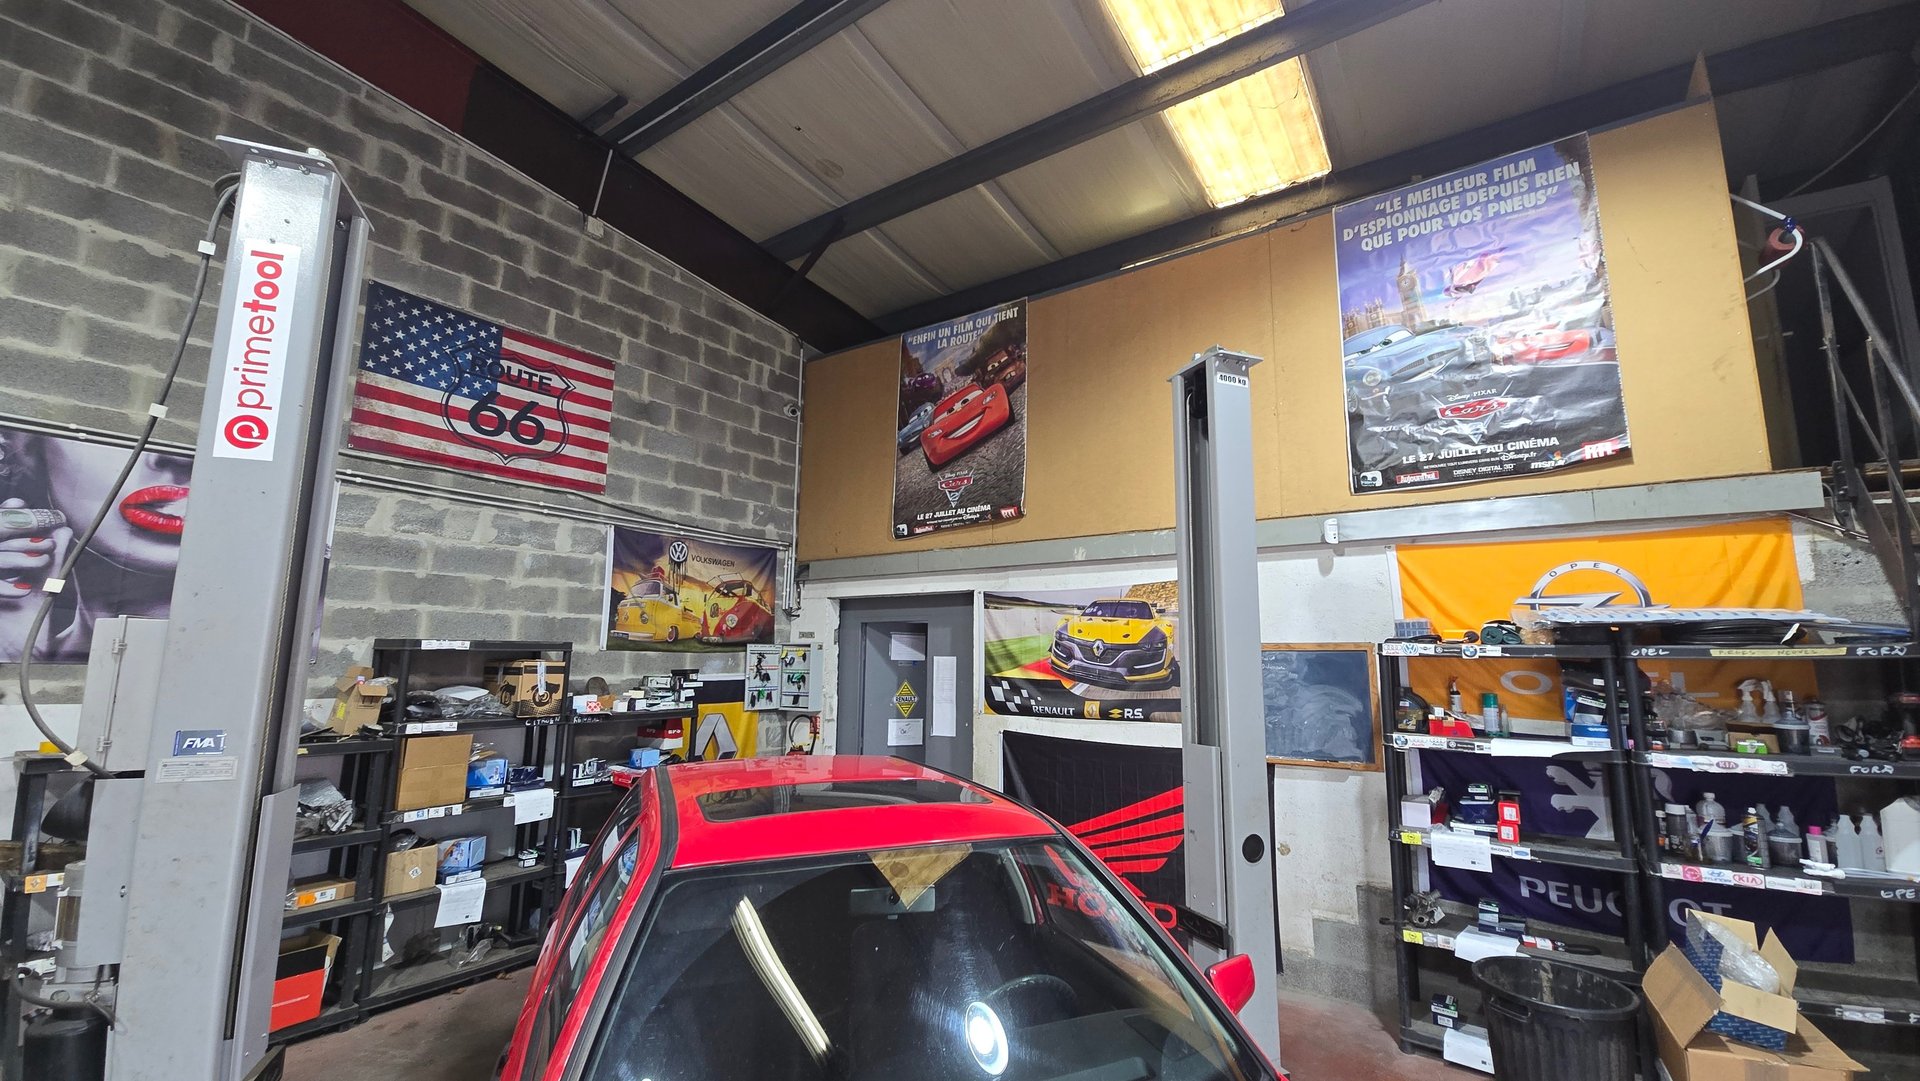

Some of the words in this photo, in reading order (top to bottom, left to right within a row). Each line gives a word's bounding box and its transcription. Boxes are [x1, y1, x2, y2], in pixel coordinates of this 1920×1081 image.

[1407, 172, 1488, 206] MEILLEUR
[1493, 157, 1536, 182] FILM
[1466, 177, 1529, 206] DEPUIS
[1535, 161, 1581, 188] RIEN
[1361, 232, 1393, 251] QUE
[1397, 218, 1444, 243] POUR
[1447, 208, 1482, 225] VOS
[233, 250, 284, 411] primetool
[938, 326, 951, 338] UN
[953, 320, 974, 335] FILM
[975, 317, 992, 328] QUI
[993, 307, 1019, 323] TIENT
[937, 339, 948, 349] LA
[471, 357, 553, 393] ROUTE
[1473, 388, 1497, 397] PIXAR
[468, 391, 545, 445] 66
[1402, 455, 1417, 464] LE
[1419, 453, 1434, 462] 27
[1438, 447, 1482, 460] JUILLET
[1486, 442, 1504, 454] AU
[1507, 437, 1560, 450] CINÉMA
[925, 512, 933, 520] 27
[934, 509, 956, 519] JUILLET
[956, 507, 966, 516] AU
[966, 504, 992, 514] CINÉMA
[691, 554, 736, 568] VOLKSWAGEN
[1548, 562, 1622, 578] OPEL
[1630, 647, 1670, 656] OPEL
[1855, 645, 1907, 656] FORD
[1032, 705, 1075, 716] RENAULT
[182, 737, 216, 749] FMA
[1850, 765, 1894, 775] FORD
[1738, 875, 1759, 885] KIA
